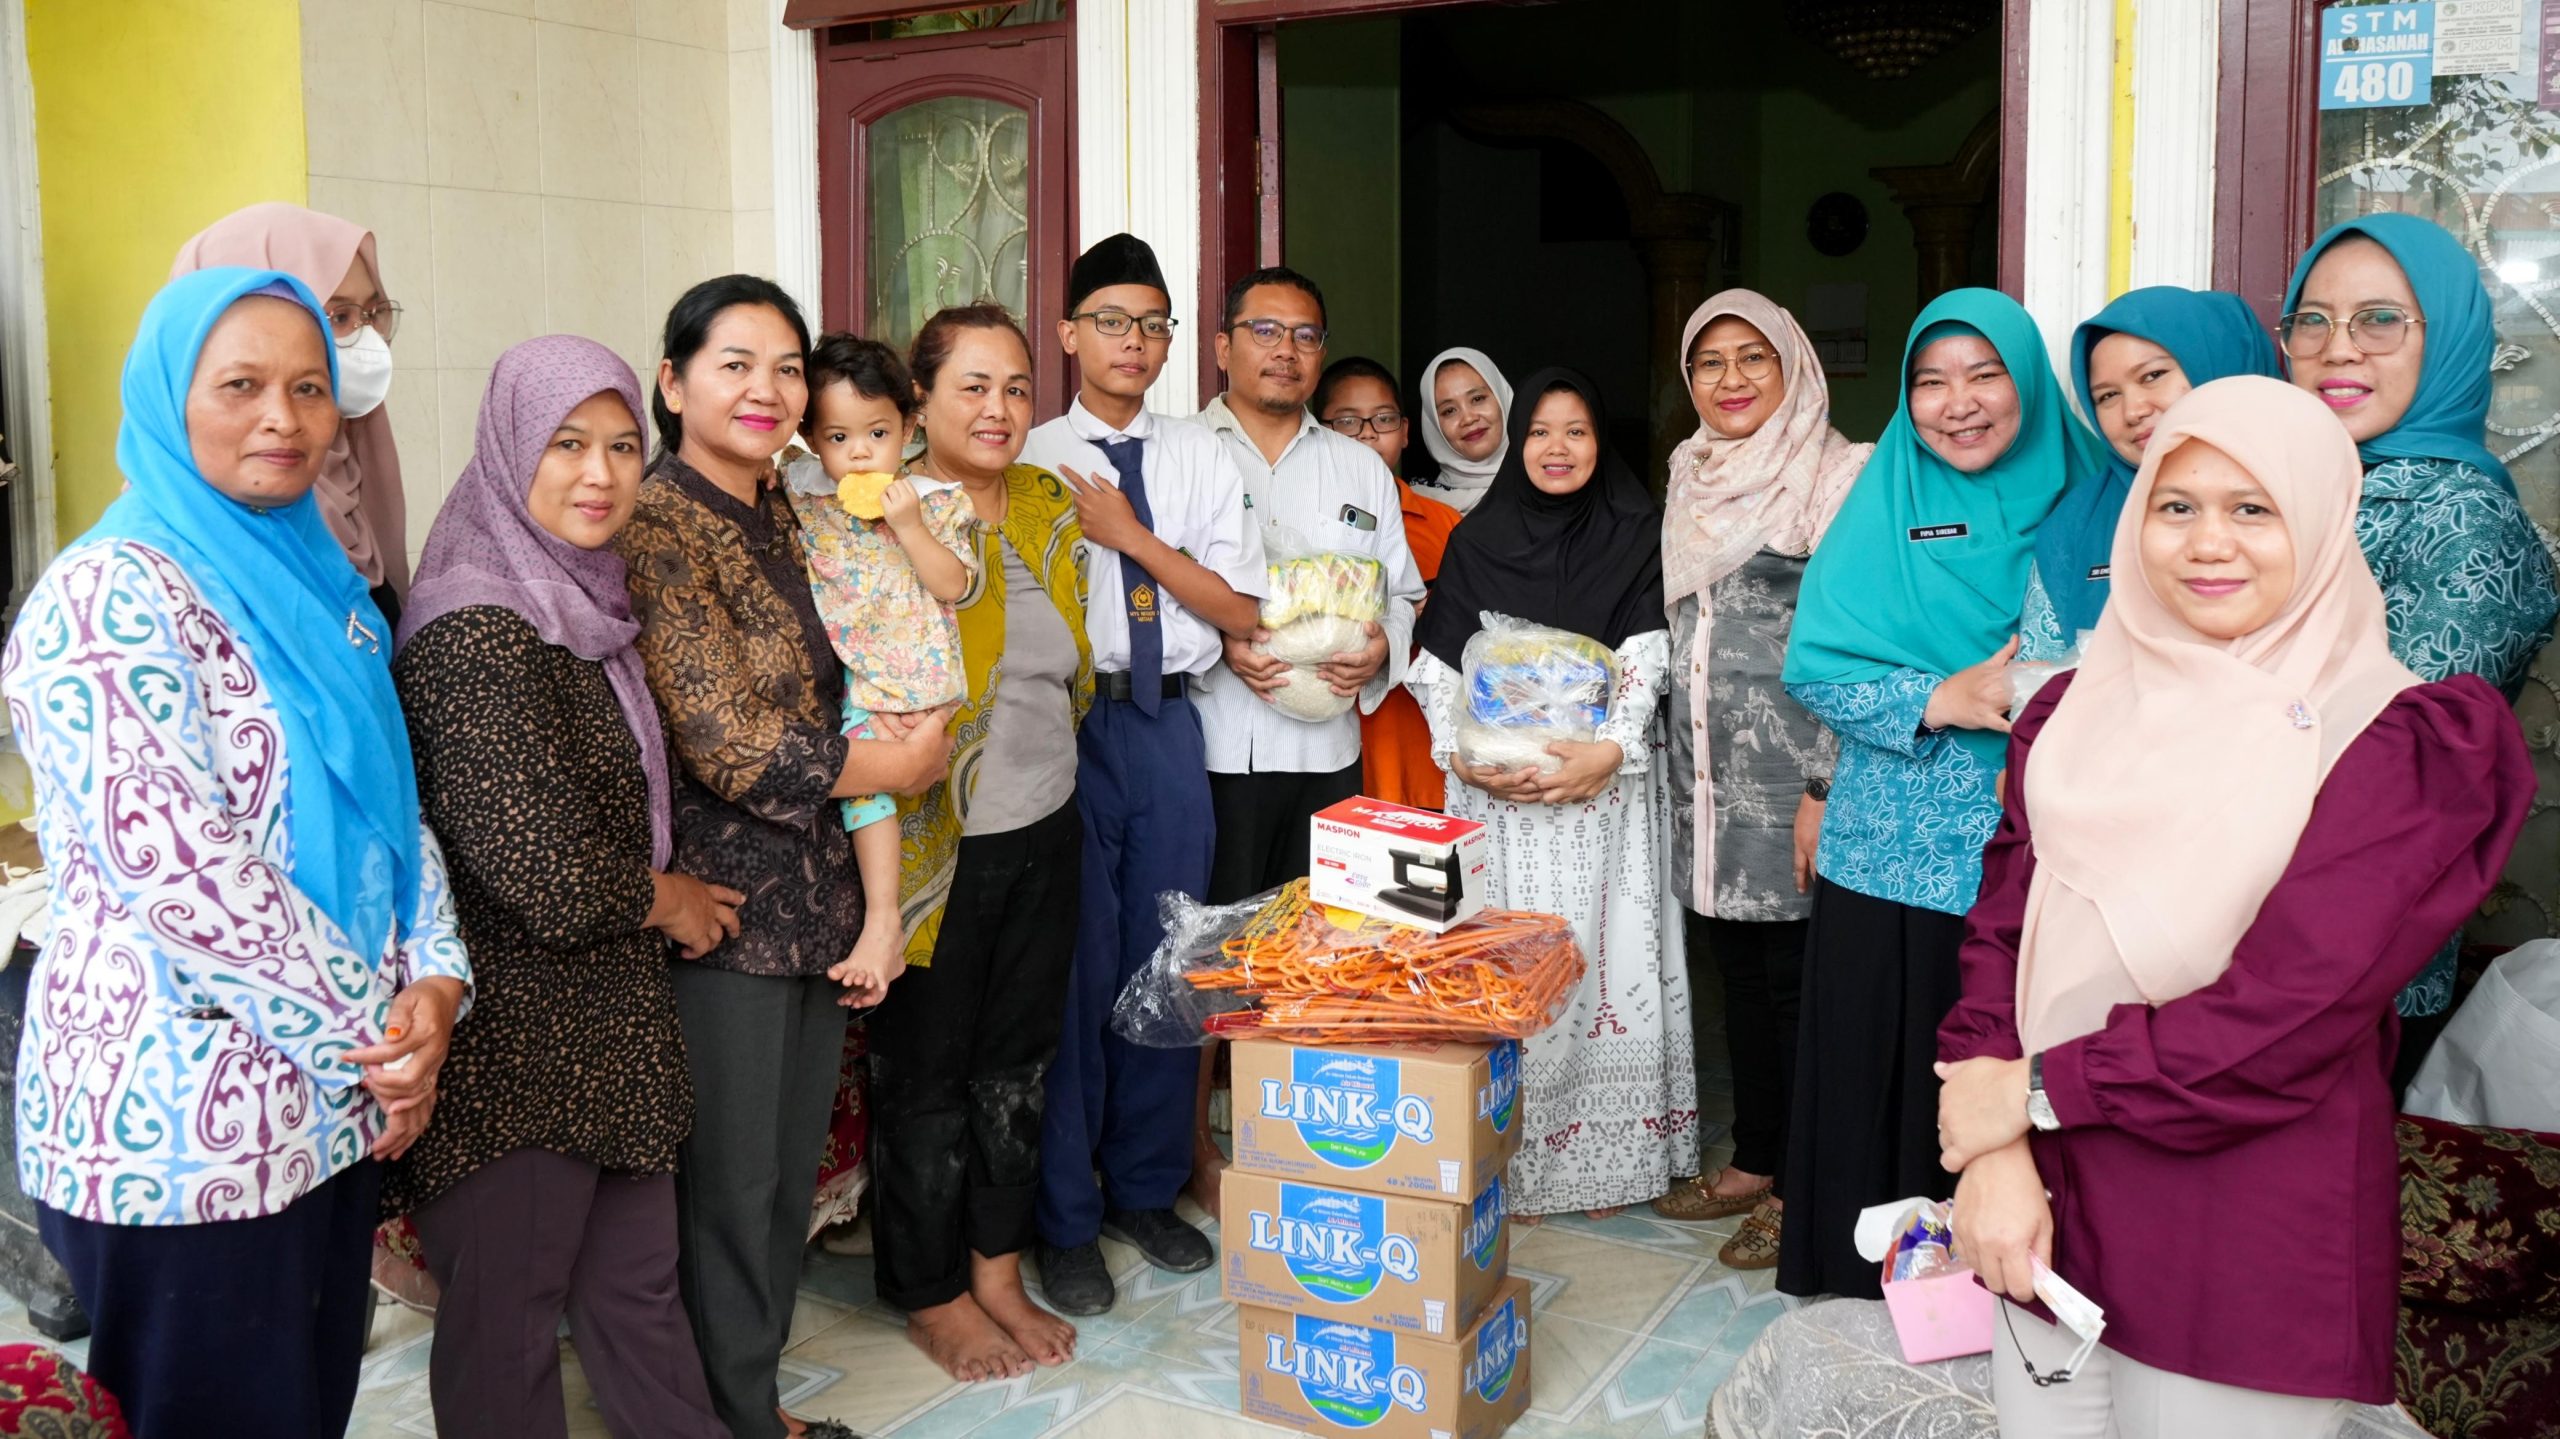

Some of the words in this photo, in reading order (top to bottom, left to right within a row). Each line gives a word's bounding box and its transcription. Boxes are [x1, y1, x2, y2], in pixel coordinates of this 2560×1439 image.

[2461, 0, 2513, 15] FKPM
[2459, 37, 2512, 52] FKPM
[2334, 61, 2413, 103] 480
[1317, 822, 1360, 839] MASPION
[1463, 832, 1486, 847] MASPION
[1317, 844, 1352, 858] ELECTRIC
[1352, 851, 1373, 863] IRON
[1261, 1079, 1434, 1143] LINK-Q
[1386, 1177, 1398, 1186] 48
[1407, 1181, 1437, 1192] 200ml
[1462, 1185, 1508, 1258] LINK-Q
[1250, 1212, 1419, 1282] LINK-Q
[1463, 1316, 1528, 1395] LINK-Q
[1266, 1334, 1427, 1412] LINK-Q
